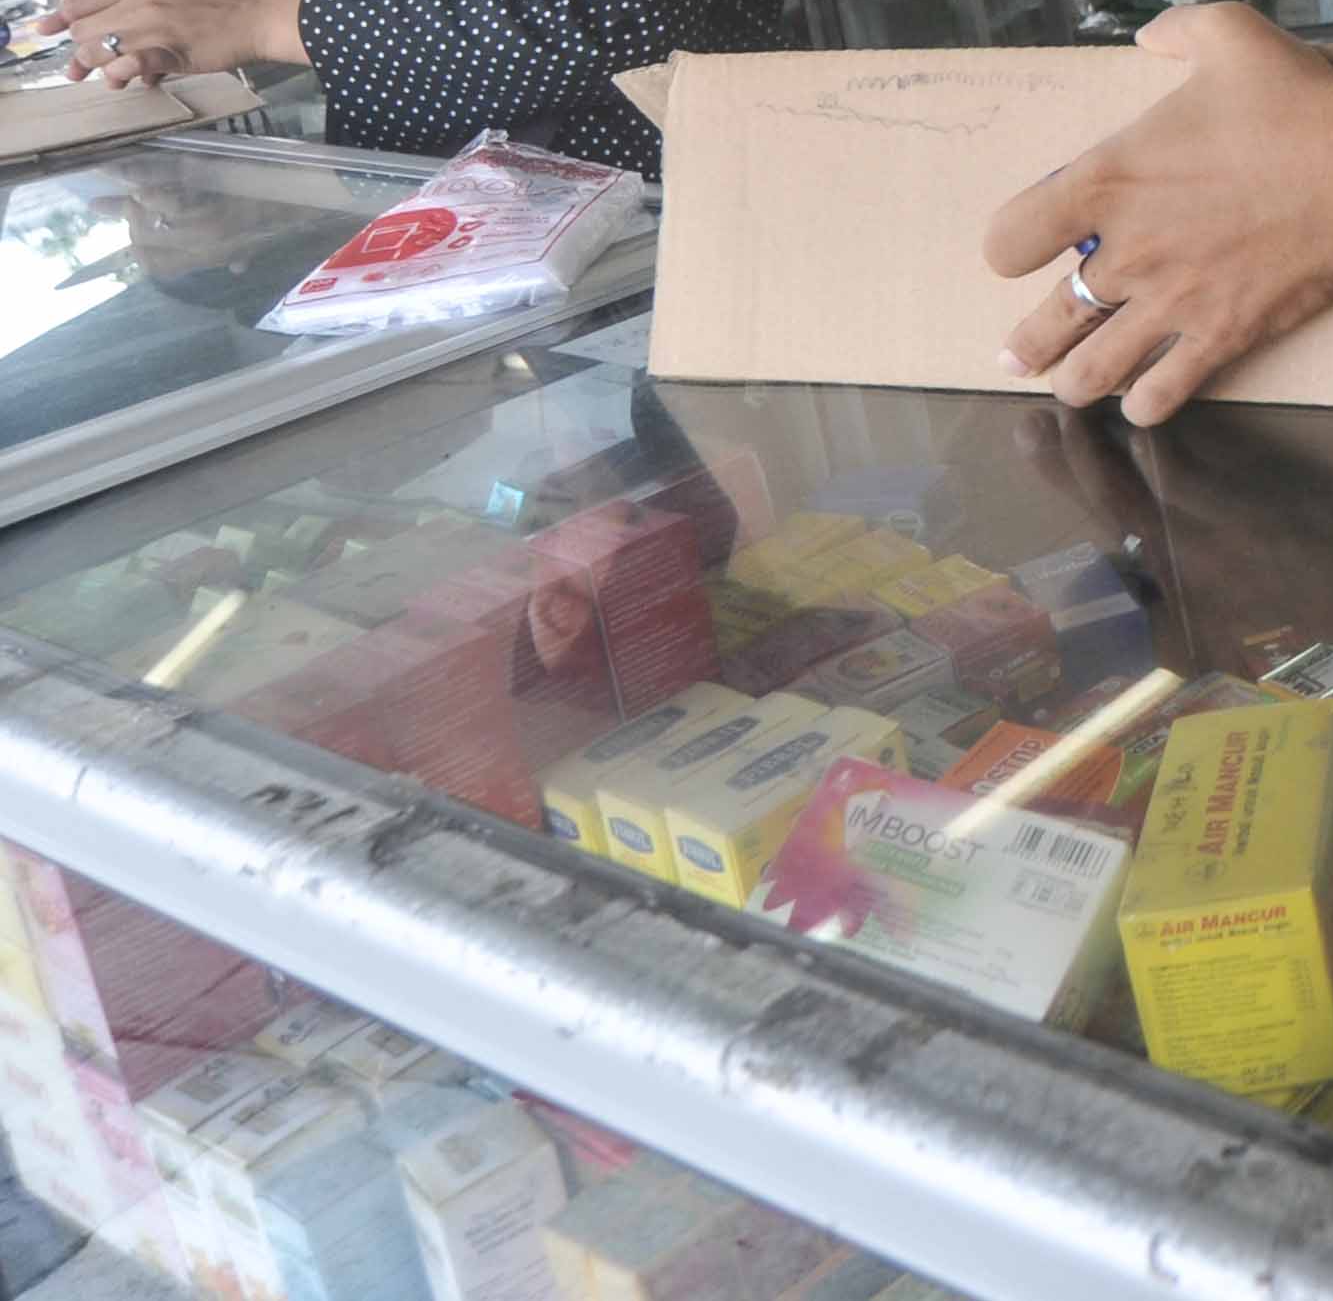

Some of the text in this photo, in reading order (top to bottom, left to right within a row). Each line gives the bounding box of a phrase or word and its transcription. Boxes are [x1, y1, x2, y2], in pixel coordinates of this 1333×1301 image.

[849, 805, 985, 865] IMBOOST
[1159, 919, 1194, 938] AIR
[1199, 906, 1287, 932] MANCUR
